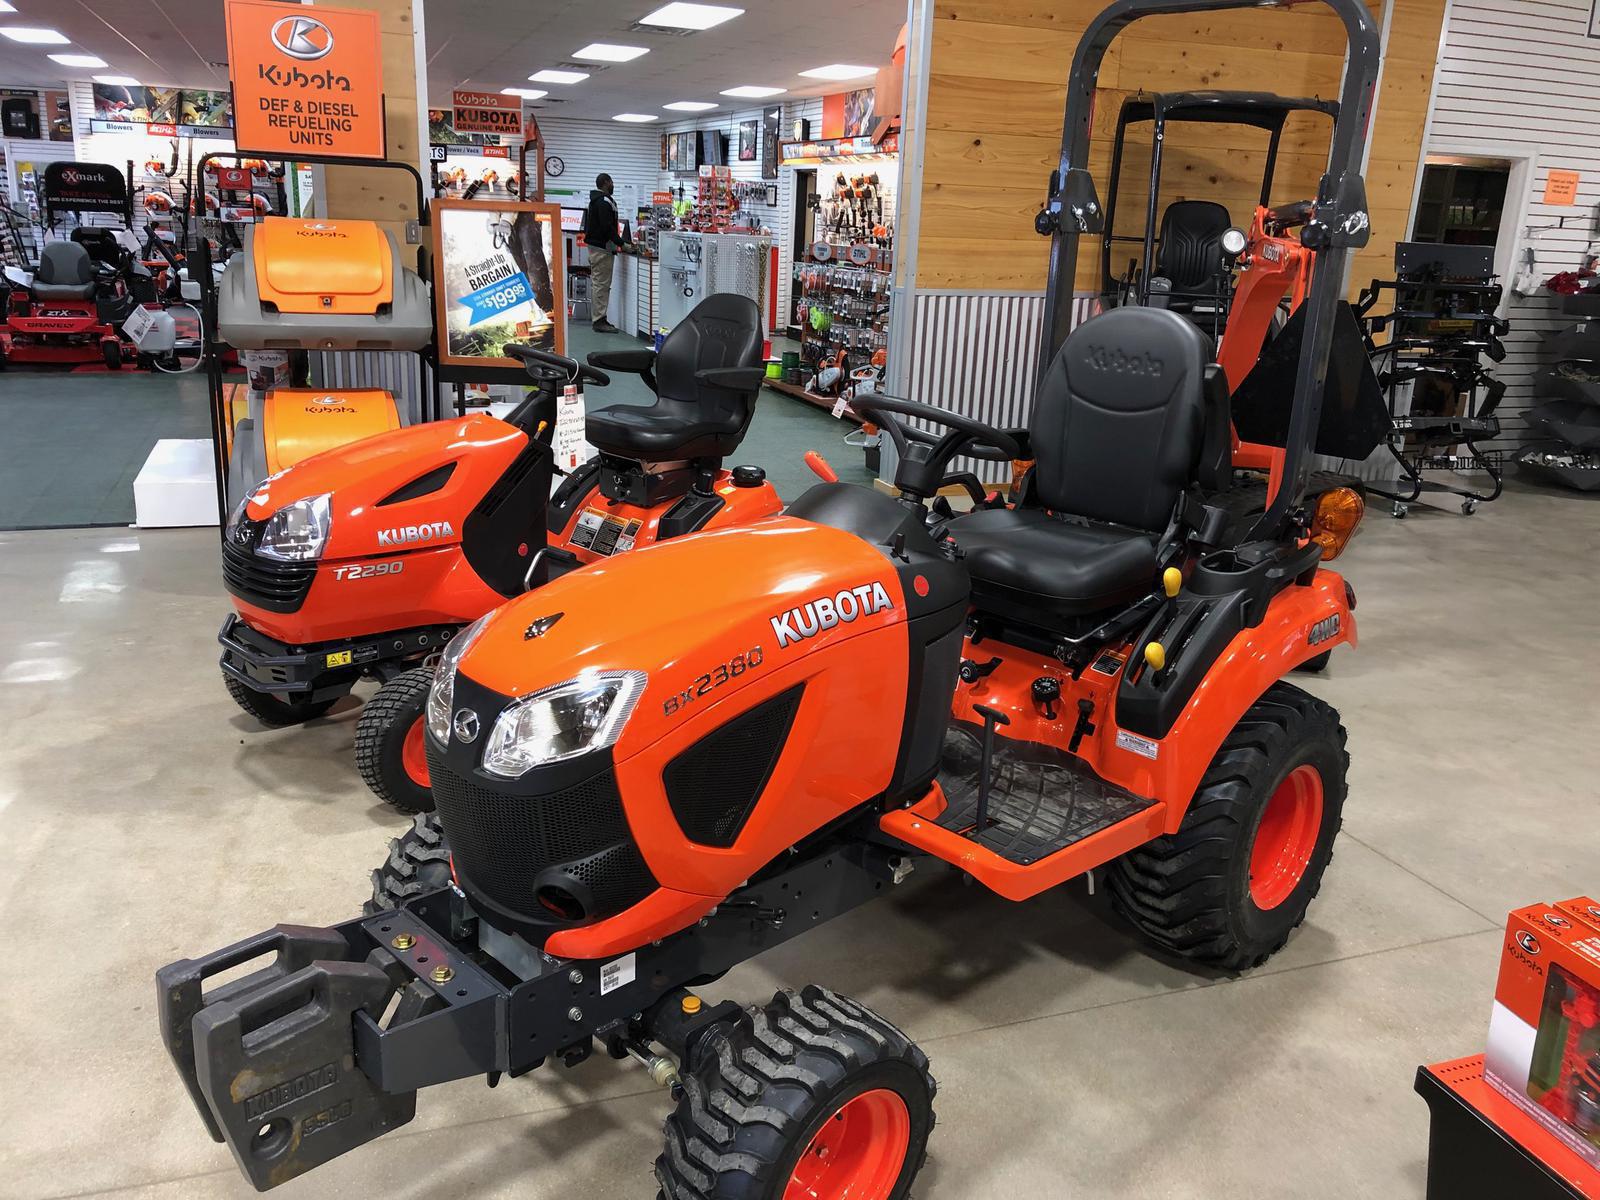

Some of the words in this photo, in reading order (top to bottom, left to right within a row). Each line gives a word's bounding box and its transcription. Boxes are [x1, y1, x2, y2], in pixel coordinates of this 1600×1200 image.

[259, 64, 351, 91] Kubota
[260, 97, 289, 112] DEF
[293, 100, 303, 113] &
[308, 101, 359, 118] DIESEL
[456, 93, 498, 105] Kubota
[106, 123, 133, 131] Blowers
[268, 114, 352, 132] REFUELING
[456, 109, 519, 124] KUBOTA
[457, 123, 493, 131] GENUINE
[193, 128, 220, 136] Blowers
[289, 131, 334, 146] UNITS
[61, 171, 105, 182] eXmark
[464, 267, 471, 278] A
[469, 253, 505, 275] Straight-Up
[469, 264, 512, 290] BARGAIN
[377, 521, 454, 546] KUBOTA
[332, 561, 404, 581] T2290
[769, 581, 894, 649] KUBOTA
[1308, 612, 1340, 646] 4WD
[662, 645, 763, 716] BX2380
[1508, 943, 1544, 976] Kubota
[245, 1063, 338, 1119] KUBOTA
